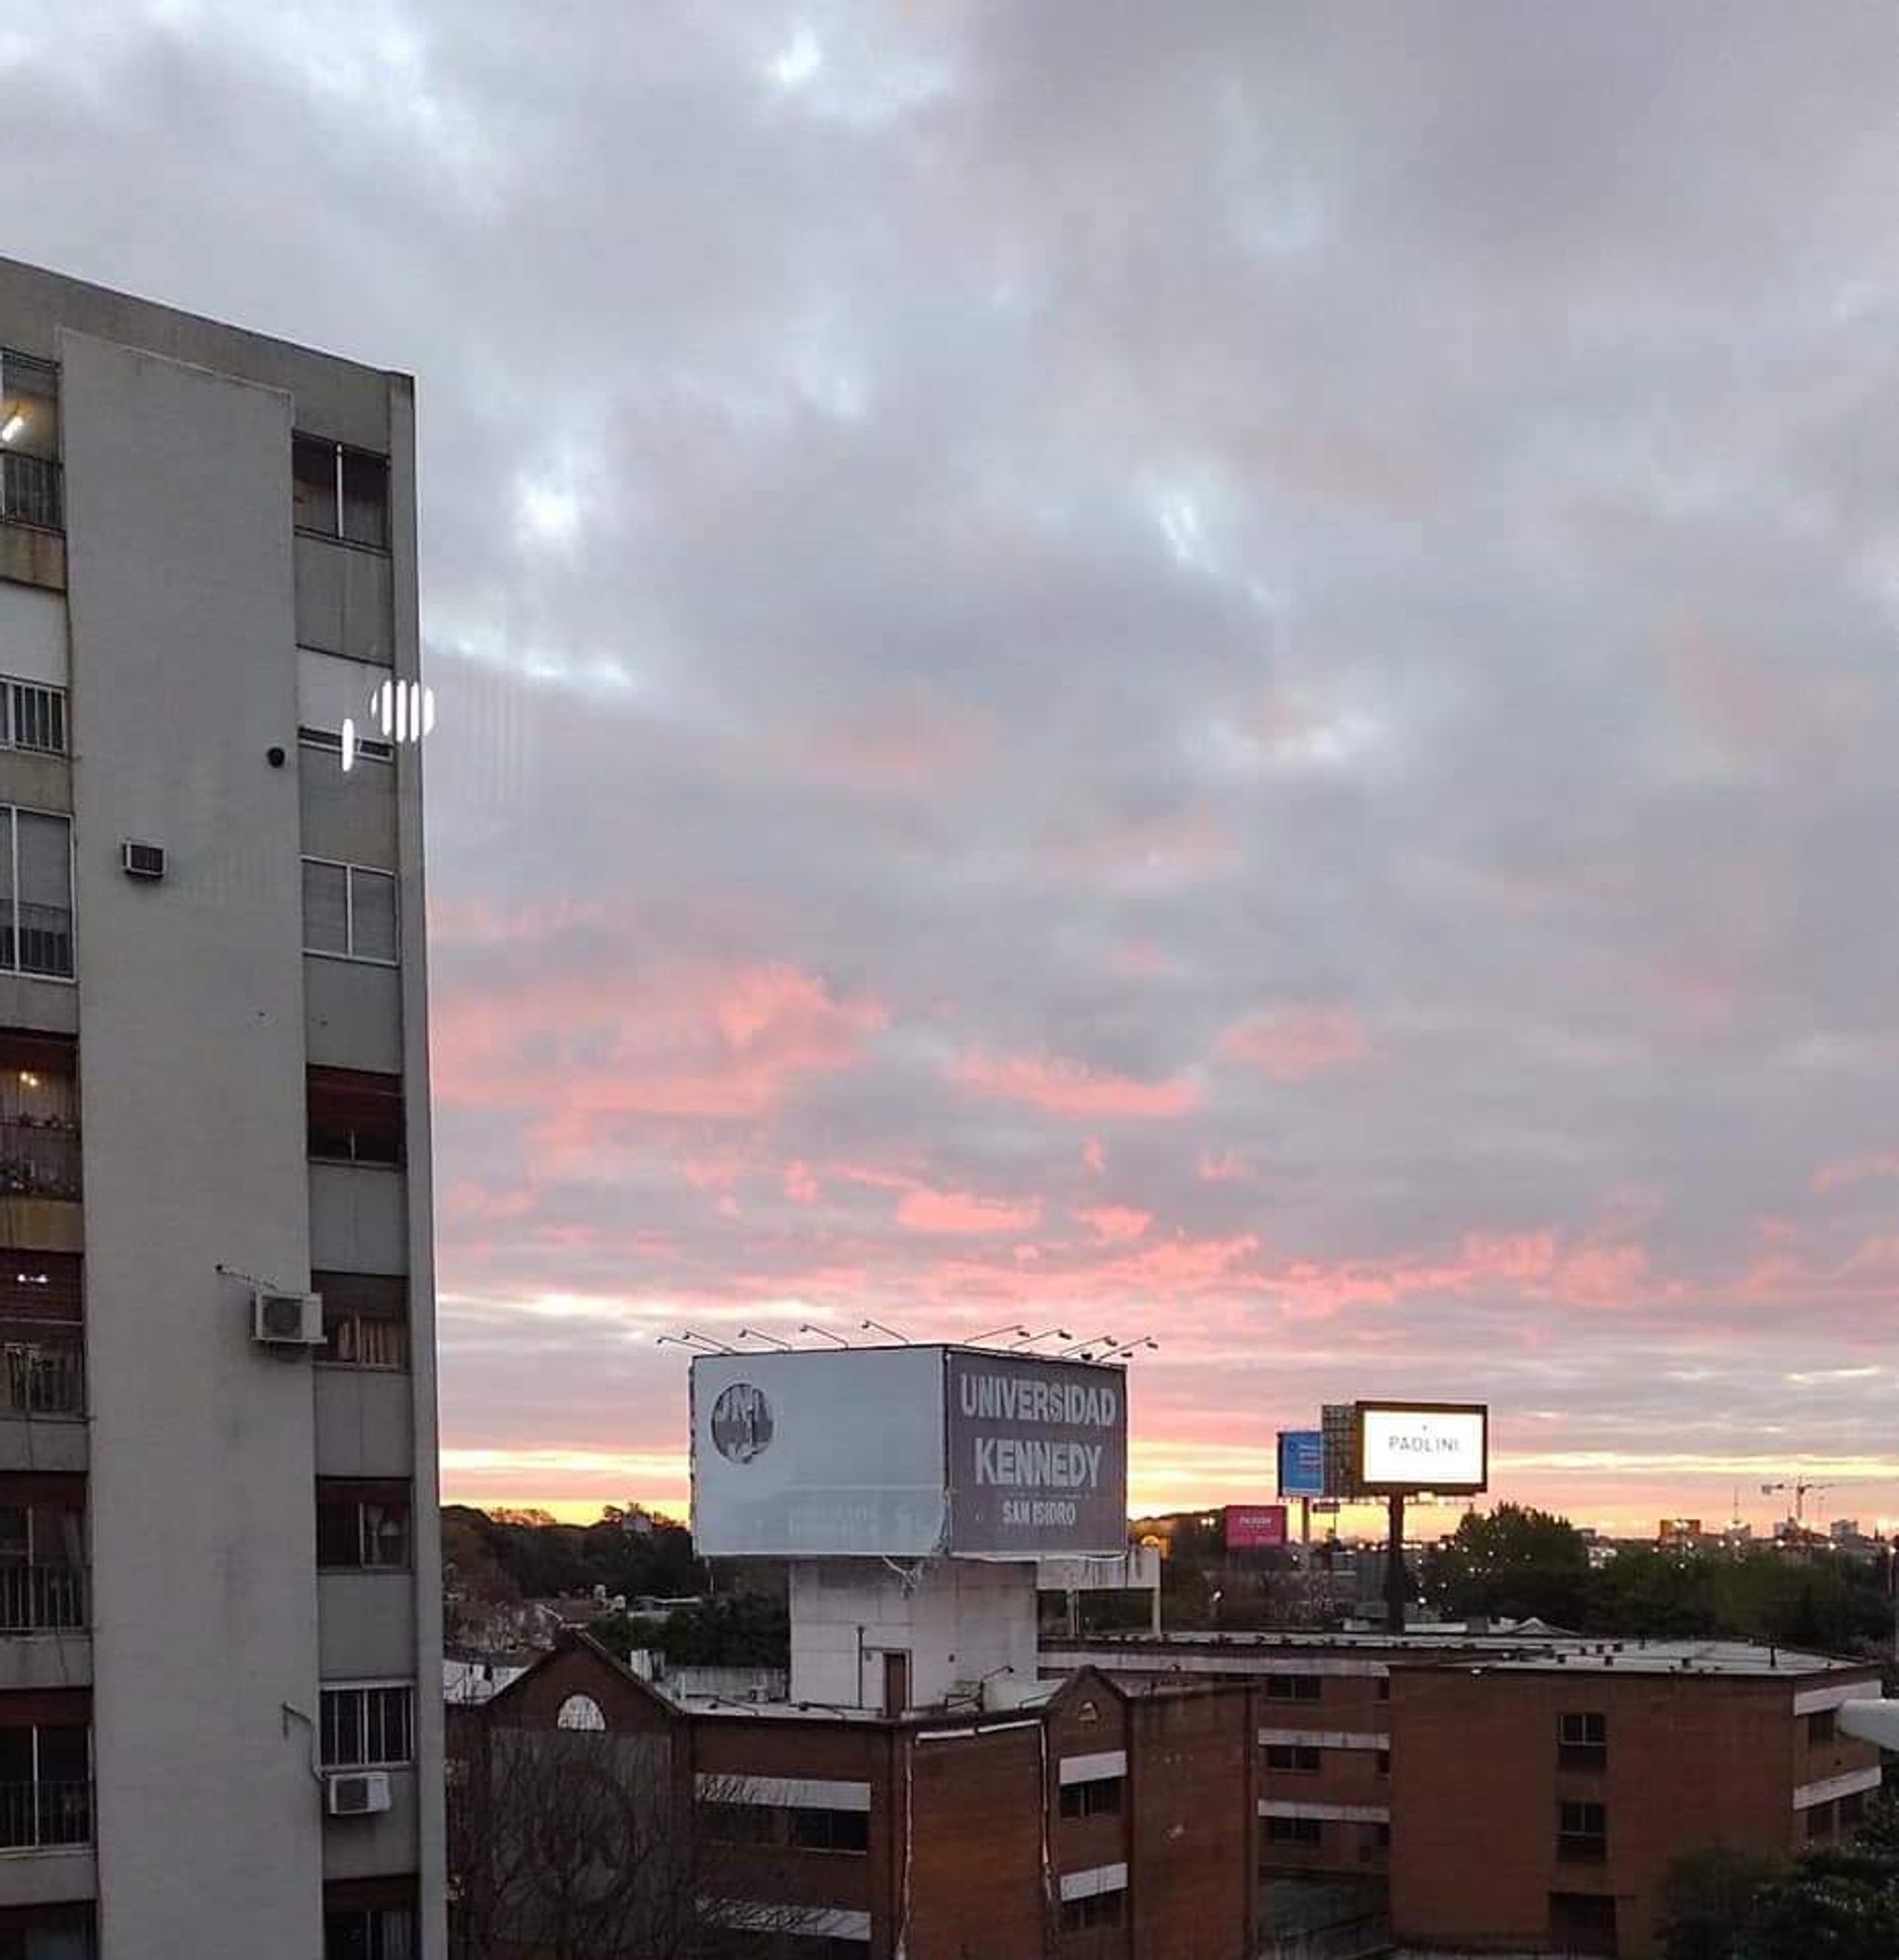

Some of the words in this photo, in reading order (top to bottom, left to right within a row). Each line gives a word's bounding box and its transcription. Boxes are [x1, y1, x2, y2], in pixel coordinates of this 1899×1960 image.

[960, 1373, 1117, 1426] UNIVERSIDAD
[975, 1438, 1103, 1487] KENNEDY
[1389, 1435, 1459, 1452] PAOLINI
[1002, 1499, 1031, 1524] SAN
[1032, 1501, 1077, 1526] ISIDRO
